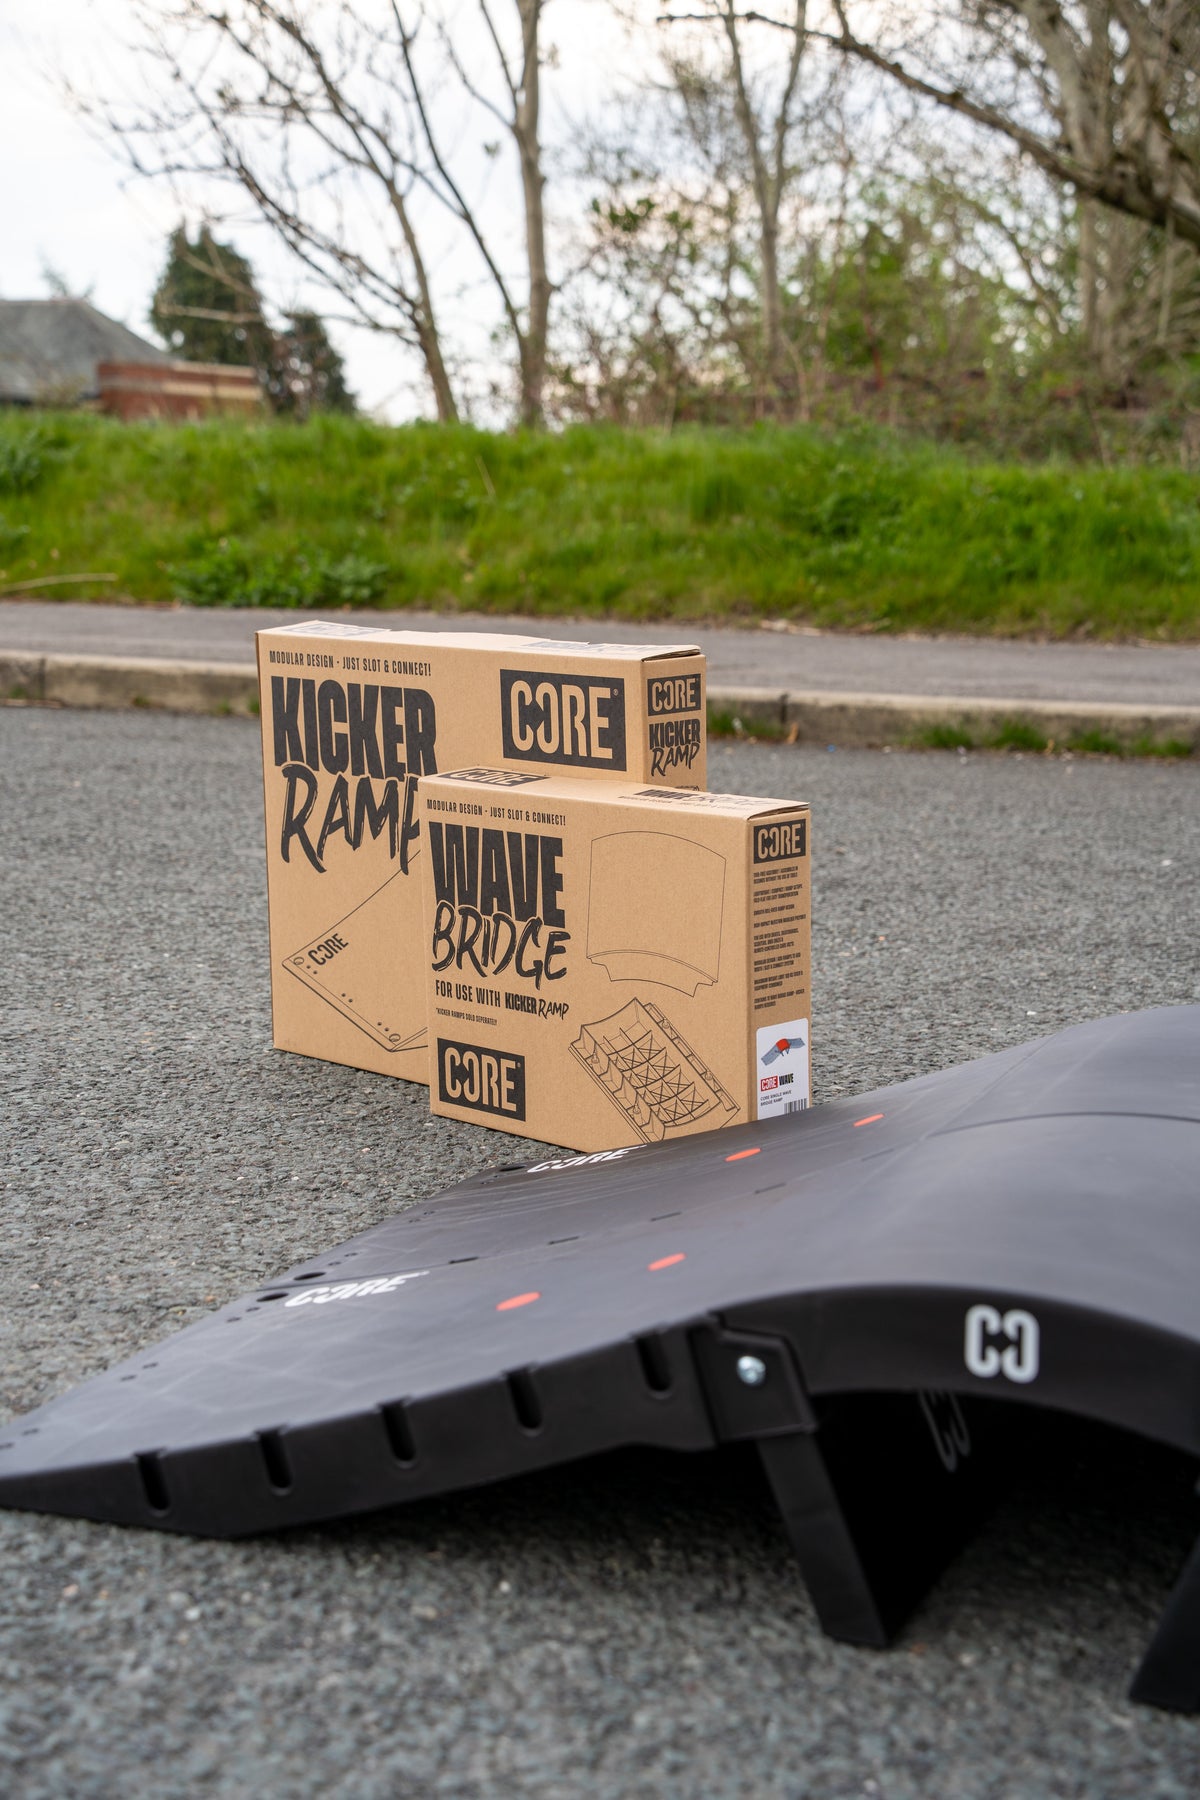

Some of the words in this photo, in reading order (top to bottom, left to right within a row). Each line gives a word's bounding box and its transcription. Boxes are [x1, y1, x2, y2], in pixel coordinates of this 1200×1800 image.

[269, 650, 304, 666] MODULAR
[306, 653, 334, 668] DESIGN
[342, 656, 360, 671] JUST
[362, 658, 381, 673] SLOT
[384, 660, 389, 673] &
[392, 660, 432, 676] CONNECT!
[651, 677, 696, 712] CORE
[271, 676, 438, 781] KICKER
[510, 680, 613, 760] CORE
[649, 718, 701, 750] KICKER
[449, 769, 538, 785] CORE
[651, 742, 700, 777] RAMP
[426, 799, 457, 813] MODULAR
[459, 802, 482, 816] DESIGN
[490, 806, 505, 818] JUST
[507, 808, 523, 821] SLOT
[525, 811, 530, 822] &
[532, 811, 566, 826] CONNECT!
[757, 823, 802, 859] CORE
[428, 821, 566, 928] WAVE
[308, 933, 349, 966] CORE
[431, 900, 571, 990] BRIDGE
[435, 979, 453, 998] FOR
[455, 983, 473, 1002] USE
[476, 987, 501, 1008] WITH
[505, 991, 537, 1015] KICKER
[538, 998, 570, 1020] RAMP
[444, 1046, 518, 1112] CORE
[761, 1076, 777, 1090] CORE
[779, 1073, 794, 1086] WAVE
[527, 1146, 639, 1173] CORE
[284, 1272, 420, 1308] CORE
